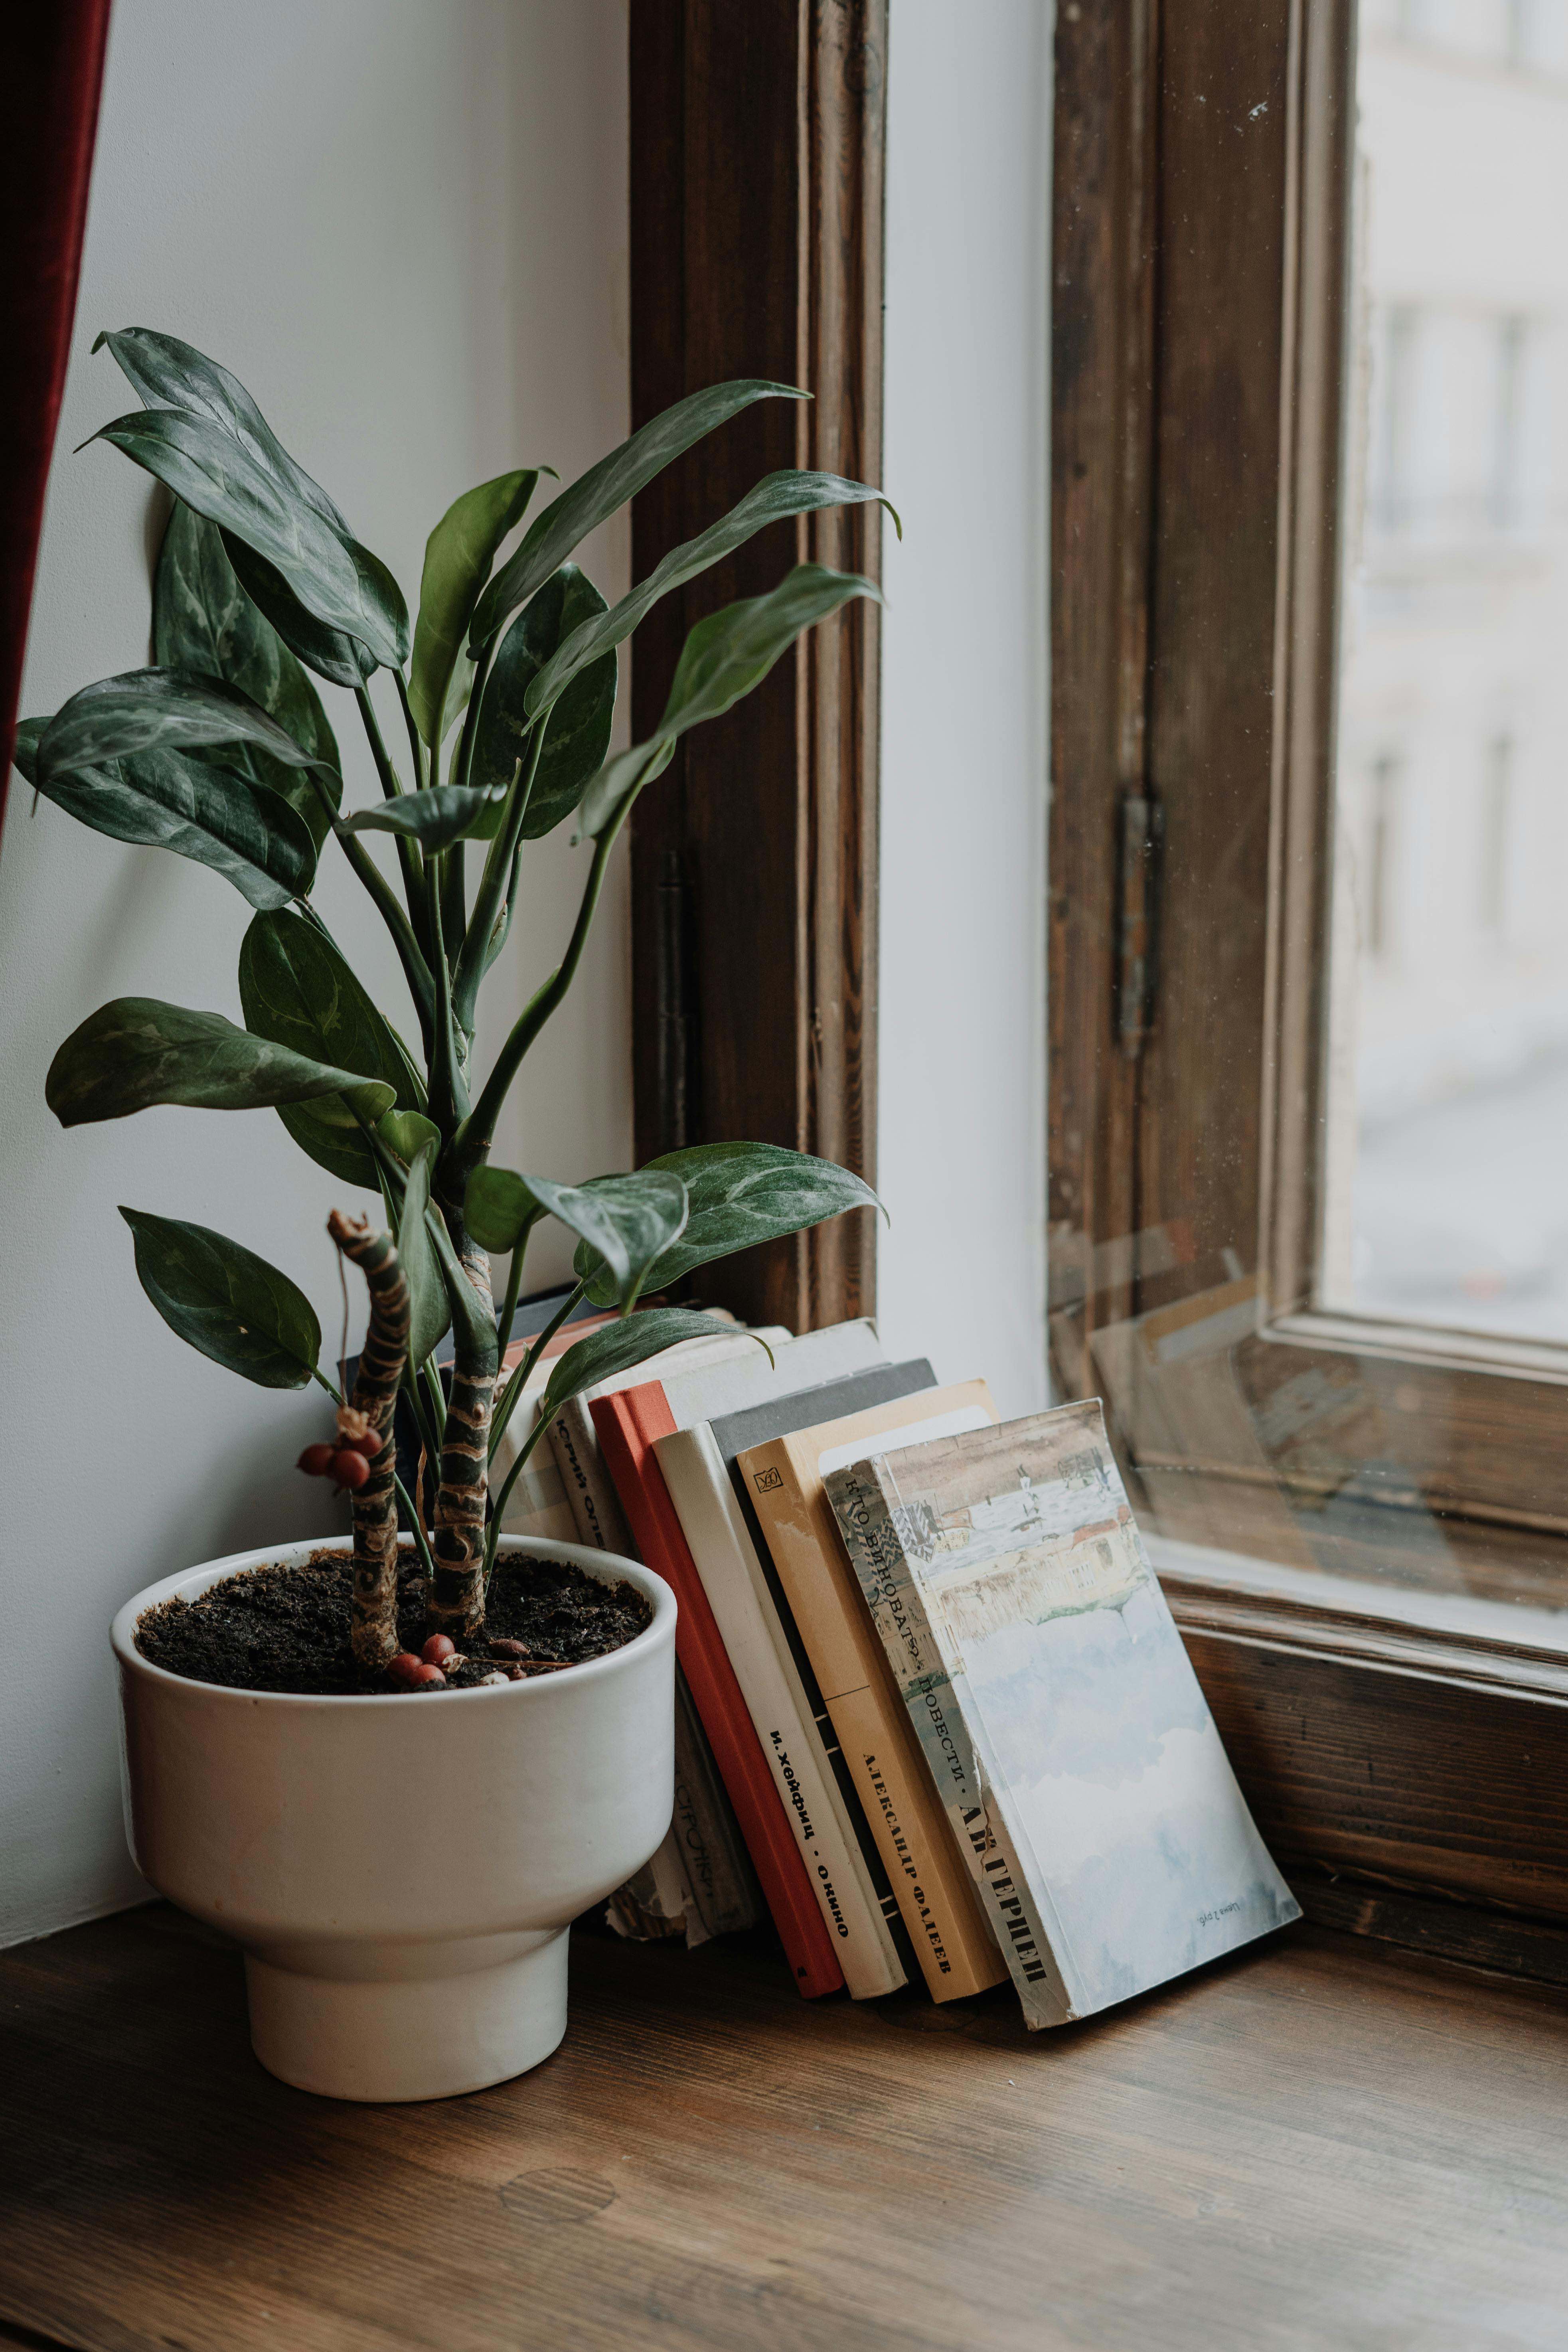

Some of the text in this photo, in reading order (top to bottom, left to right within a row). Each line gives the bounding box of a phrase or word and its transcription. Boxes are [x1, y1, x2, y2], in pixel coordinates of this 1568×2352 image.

[556, 1419, 607, 1551] ЮРИЙ ОЛЕ
[845, 1478, 869, 1525] КТО
[865, 1532, 919, 1658] ВИНОВАТ?
[918, 1677, 966, 1782] ПОВЕСТИ
[984, 1857, 1048, 1984] ГЕРЦЕН
[863, 1753, 952, 1975] АЛЕКСАНДР ФАДЕЕВ
[1197, 1902, 1240, 1927] Цена 2 руб.
